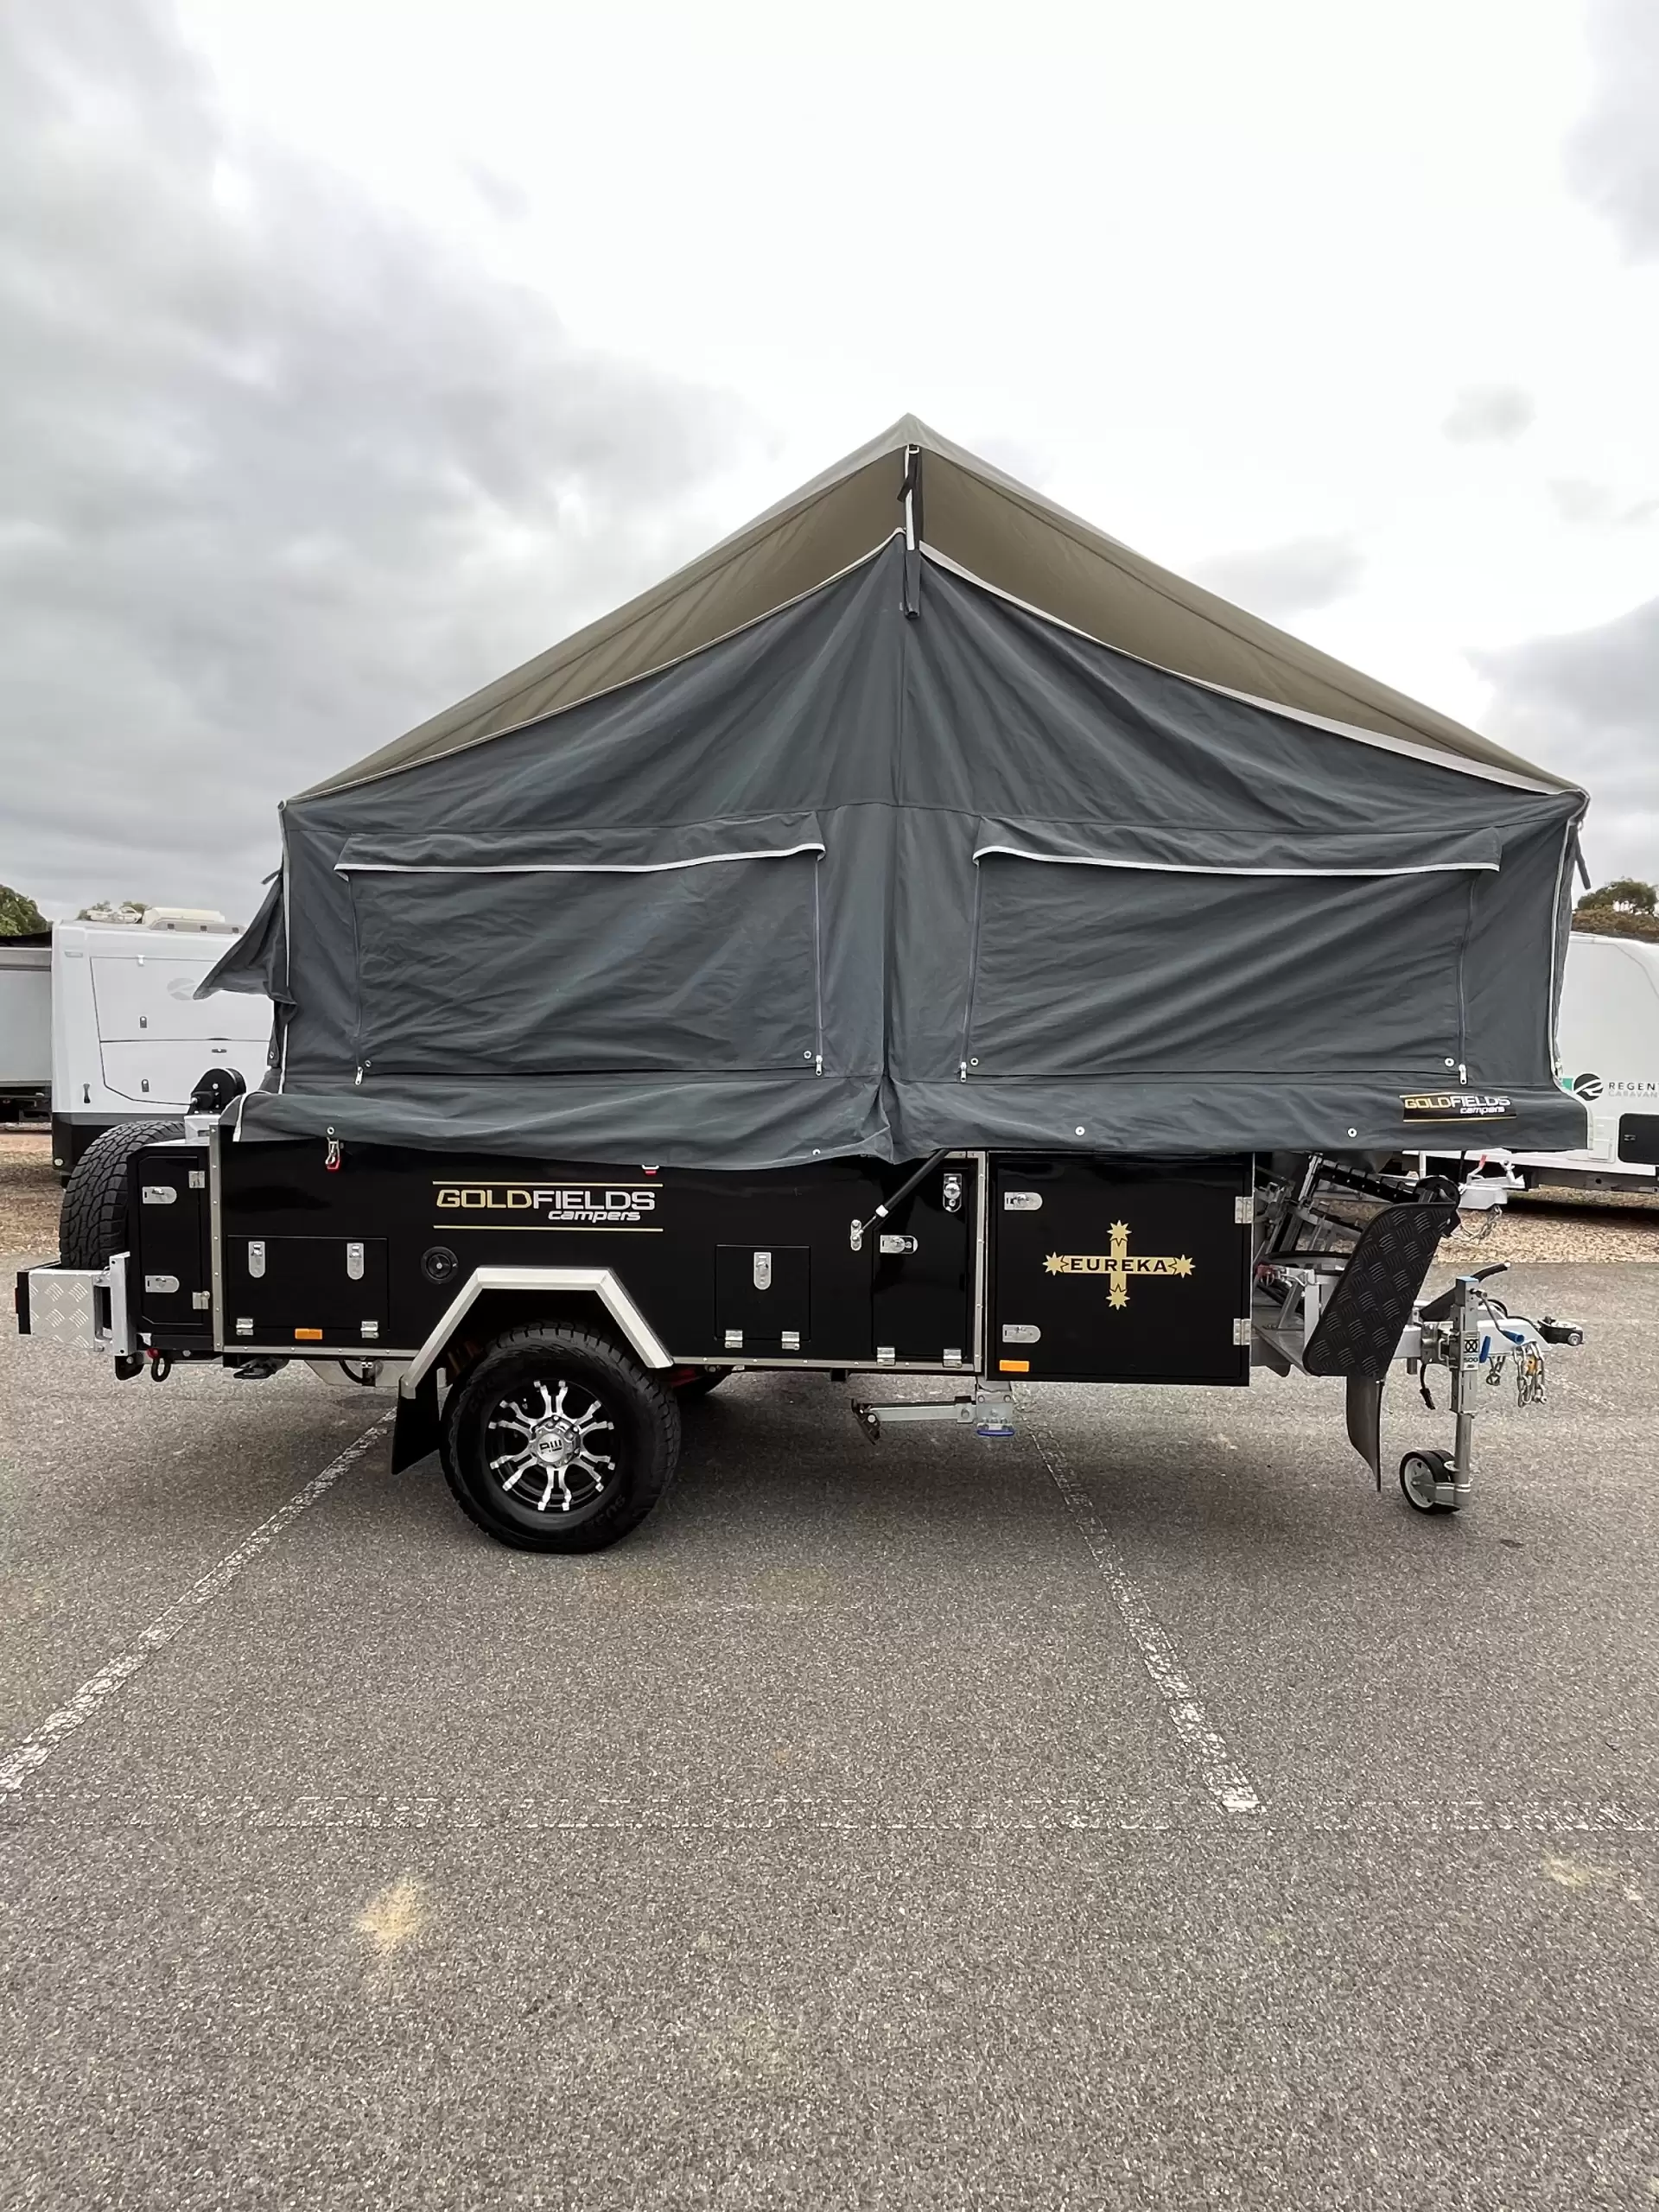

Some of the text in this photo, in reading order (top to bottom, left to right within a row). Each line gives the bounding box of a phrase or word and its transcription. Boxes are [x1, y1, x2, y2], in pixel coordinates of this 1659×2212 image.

[1608, 1082, 1659, 1090] REGEN
[1404, 1096, 1511, 1109] GOLDFIELDS
[1460, 1106, 1505, 1115] campers
[436, 1189, 656, 1211] GOLDFIELDS
[548, 1210, 641, 1224] campers
[1071, 1258, 1167, 1272] EUREKA
